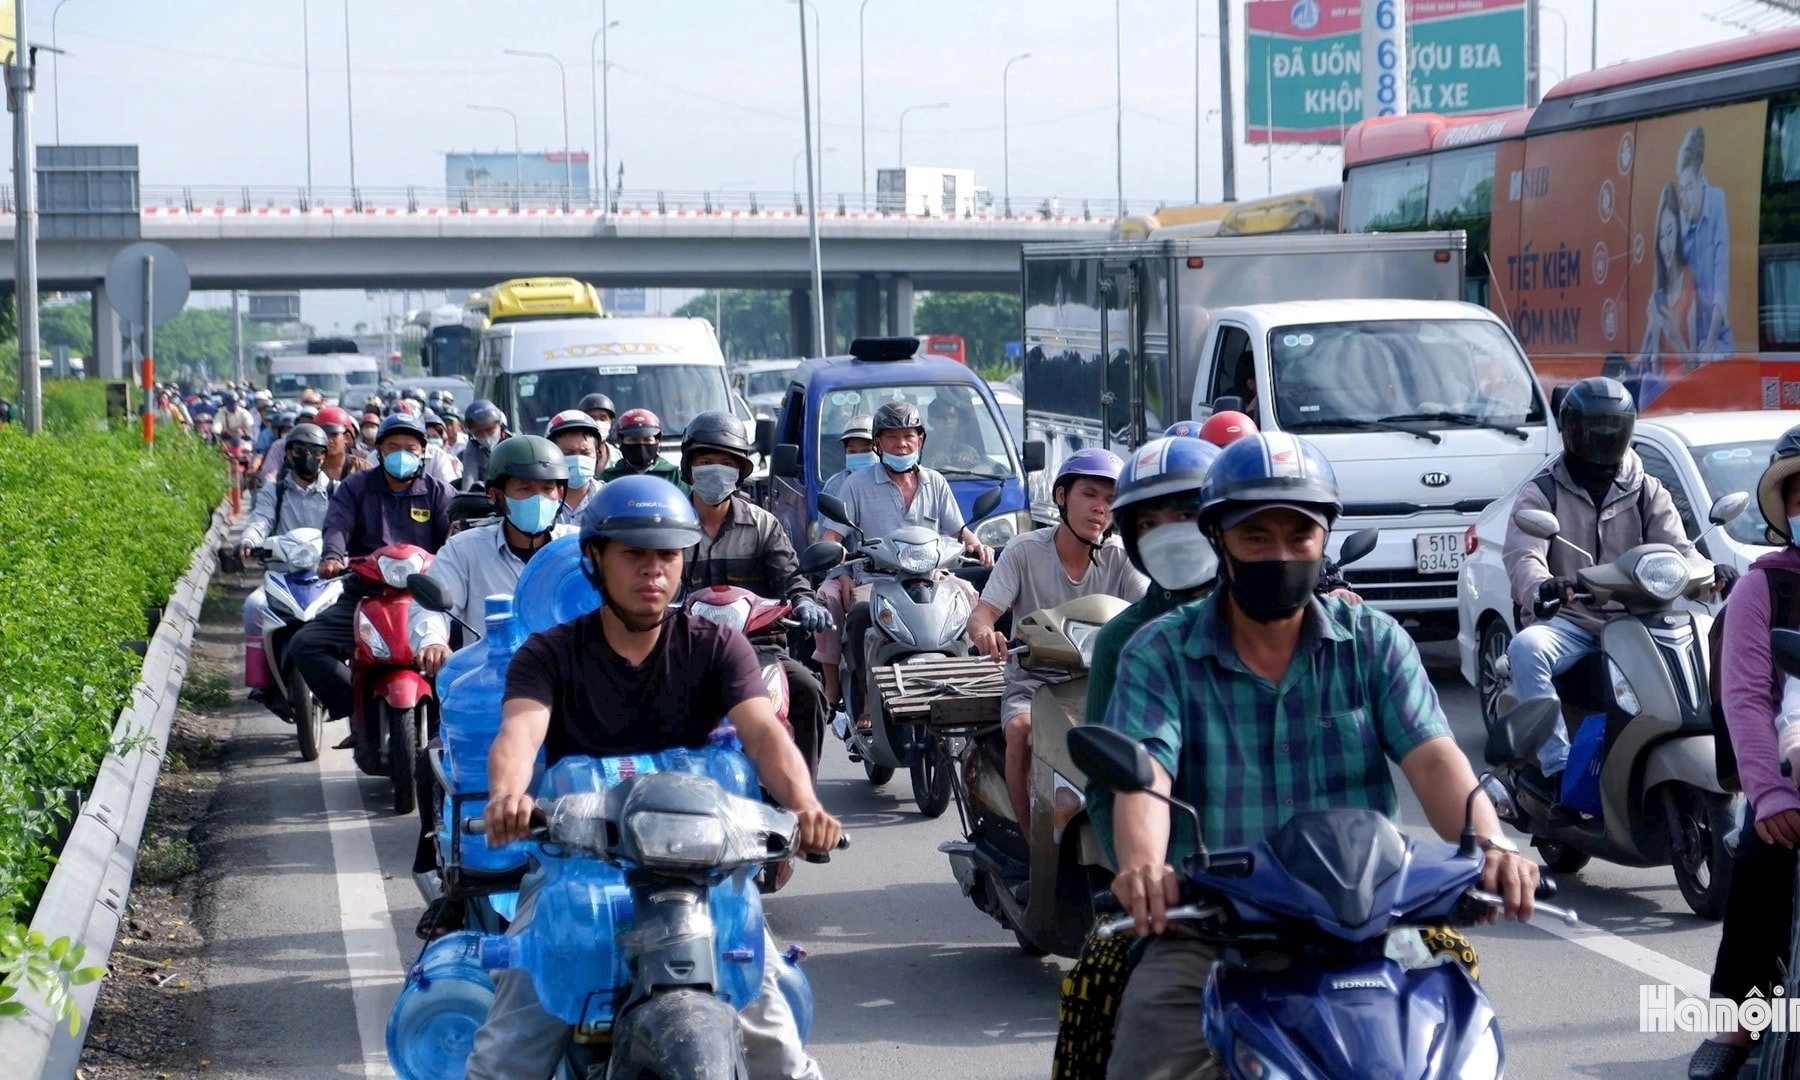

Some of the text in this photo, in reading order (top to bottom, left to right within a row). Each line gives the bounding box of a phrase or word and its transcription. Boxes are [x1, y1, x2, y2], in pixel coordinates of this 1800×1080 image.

[1273, 41, 1502, 78] ĐÃ UỐN ƯỢU BIA
[1304, 77, 1468, 114] KHÔN ÁI XE
[1507, 240, 1581, 300] TIẾT KIỆM
[1549, 307, 1581, 345] NAY
[544, 343, 686, 361] LUXURY
[1425, 473, 1447, 484] KIA
[1429, 535, 1458, 552] 51D
[1332, 980, 1387, 990] HONDA
